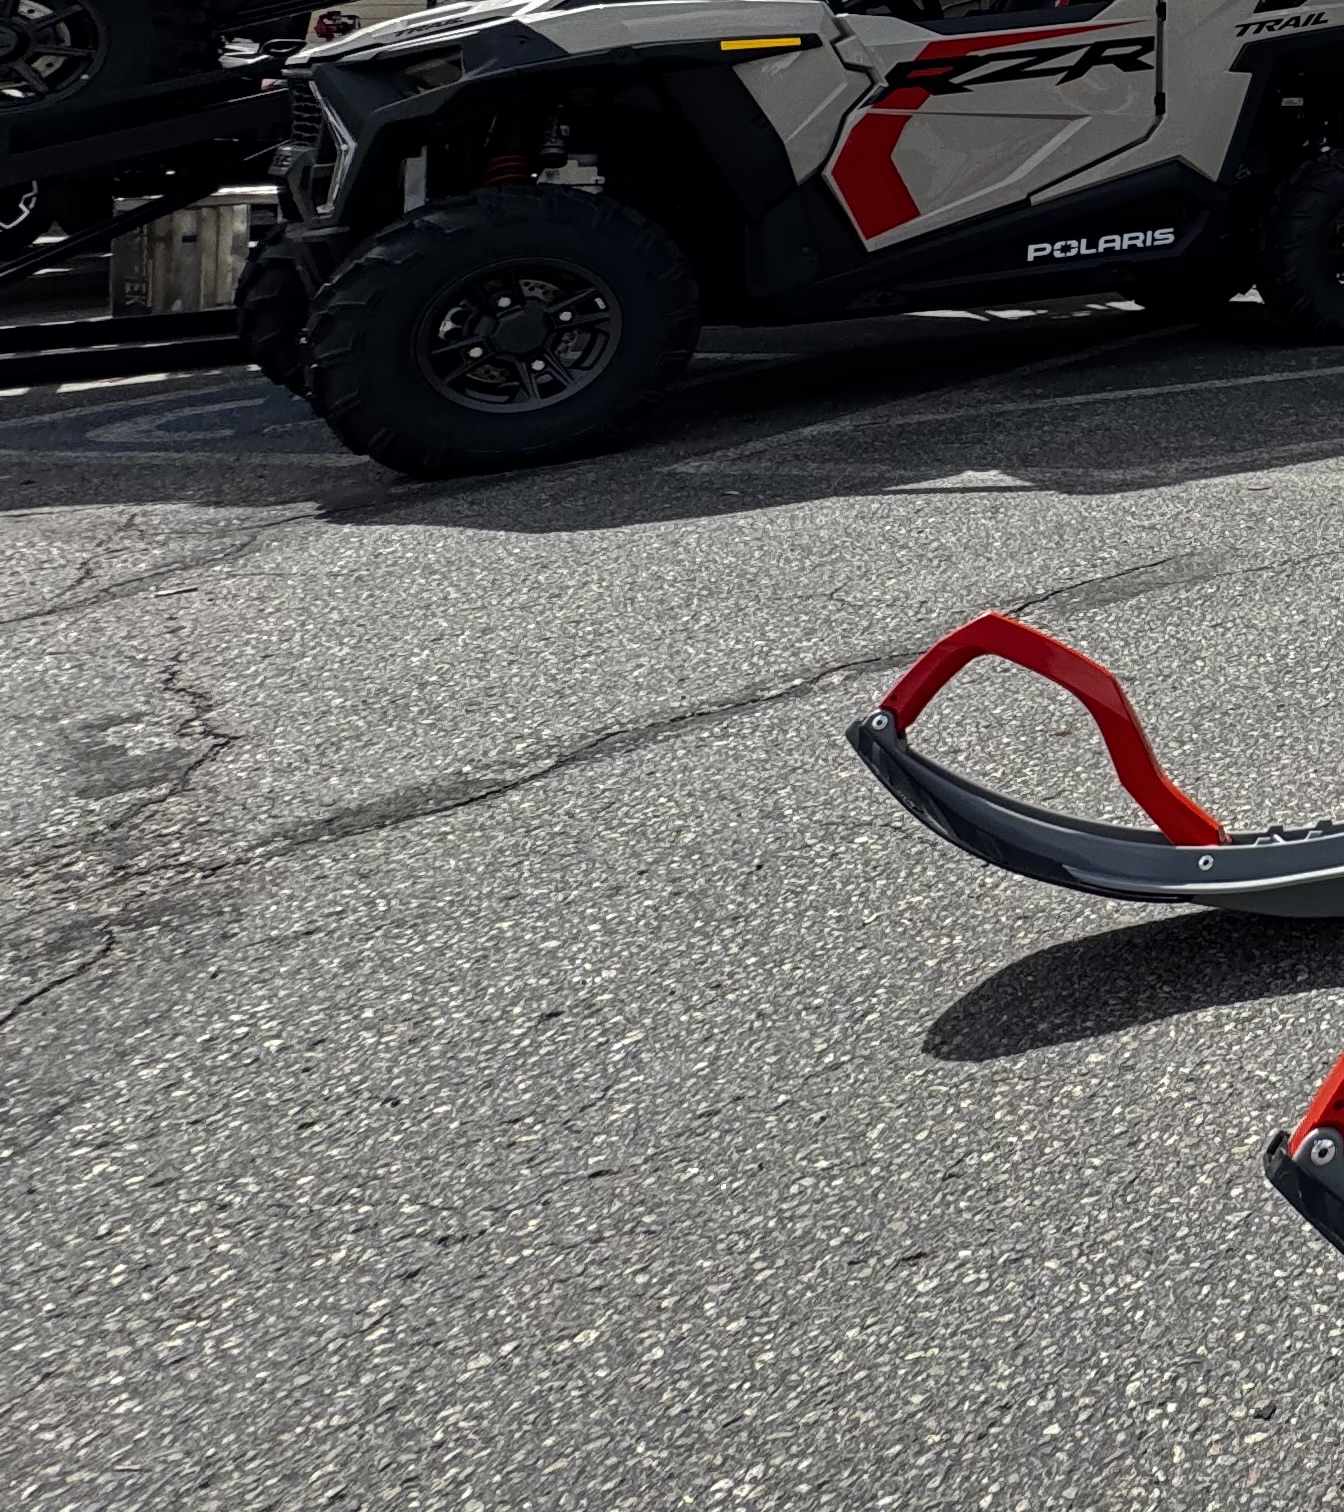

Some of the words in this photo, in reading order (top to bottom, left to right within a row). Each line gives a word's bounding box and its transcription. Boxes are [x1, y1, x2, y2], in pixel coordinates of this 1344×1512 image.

[1235, 11, 1329, 37] TRAIL
[858, 36, 1155, 109] RZR
[1026, 227, 1176, 262] POLARIS
